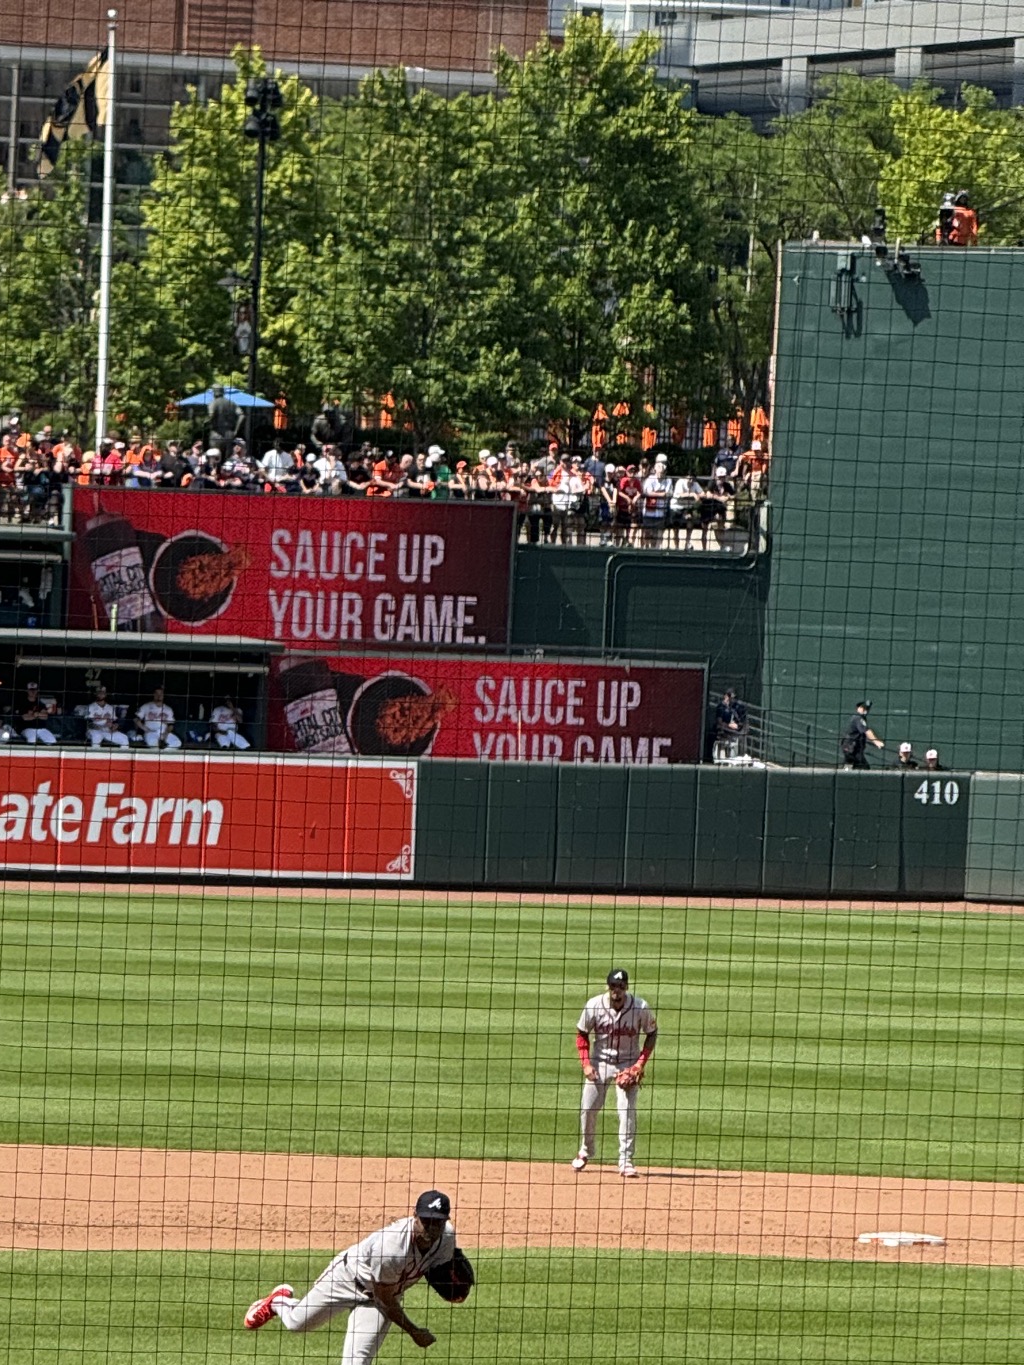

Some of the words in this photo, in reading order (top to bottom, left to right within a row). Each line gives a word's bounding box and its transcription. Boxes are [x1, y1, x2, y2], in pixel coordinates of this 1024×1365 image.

[270, 528, 388, 582] SAUCE
[398, 533, 445, 584] UP
[268, 587, 364, 640] YOUR
[373, 592, 487, 645] GAME.
[473, 675, 586, 726] SAUCE
[596, 680, 642, 728] UP
[473, 732, 564, 762] YOUR
[914, 779, 960, 806] 410
